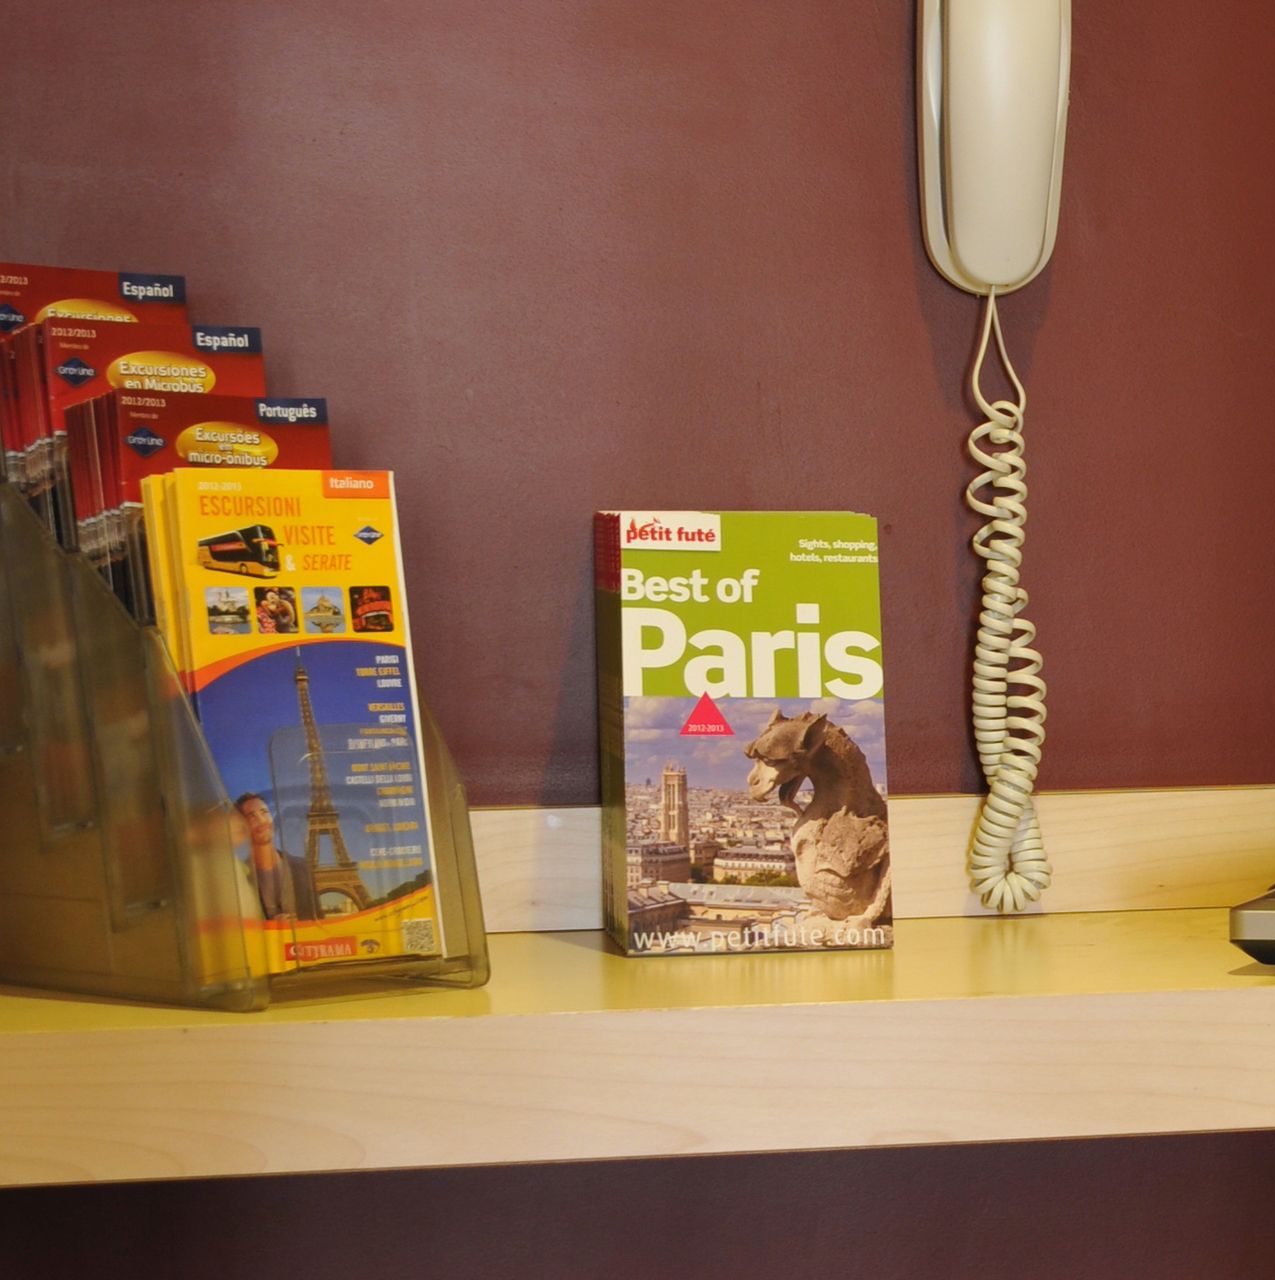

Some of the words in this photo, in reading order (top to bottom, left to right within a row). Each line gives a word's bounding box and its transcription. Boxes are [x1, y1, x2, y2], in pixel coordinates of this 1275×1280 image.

[122, 282, 174, 300] Español
[51, 327, 97, 338] 2012/2013
[196, 332, 249, 350] Español
[119, 362, 207, 378] Excursiones
[125, 381, 142, 389] en
[144, 377, 204, 393] Microbús
[121, 396, 167, 408] 2012/2013
[259, 403, 317, 422] Português
[196, 428, 260, 444] Excursões
[188, 450, 269, 467] micro-ônibus
[329, 477, 374, 490] Italiano
[200, 495, 301, 517] ESCURSIONI
[282, 525, 335, 545] VISITE
[626, 523, 672, 543] petit
[677, 527, 716, 542] futé
[798, 539, 831, 551] Sights,
[832, 539, 878, 552] shopping,
[285, 555, 296, 571] &
[303, 554, 352, 571] SERATE
[790, 552, 822, 563] hotels,
[823, 553, 879, 563] restaurants
[621, 568, 710, 603] Best
[716, 568, 760, 603] of
[621, 603, 883, 700] Paris
[688, 723, 725, 732] 2012-2013
[633, 923, 886, 950] www.petitfute.com
